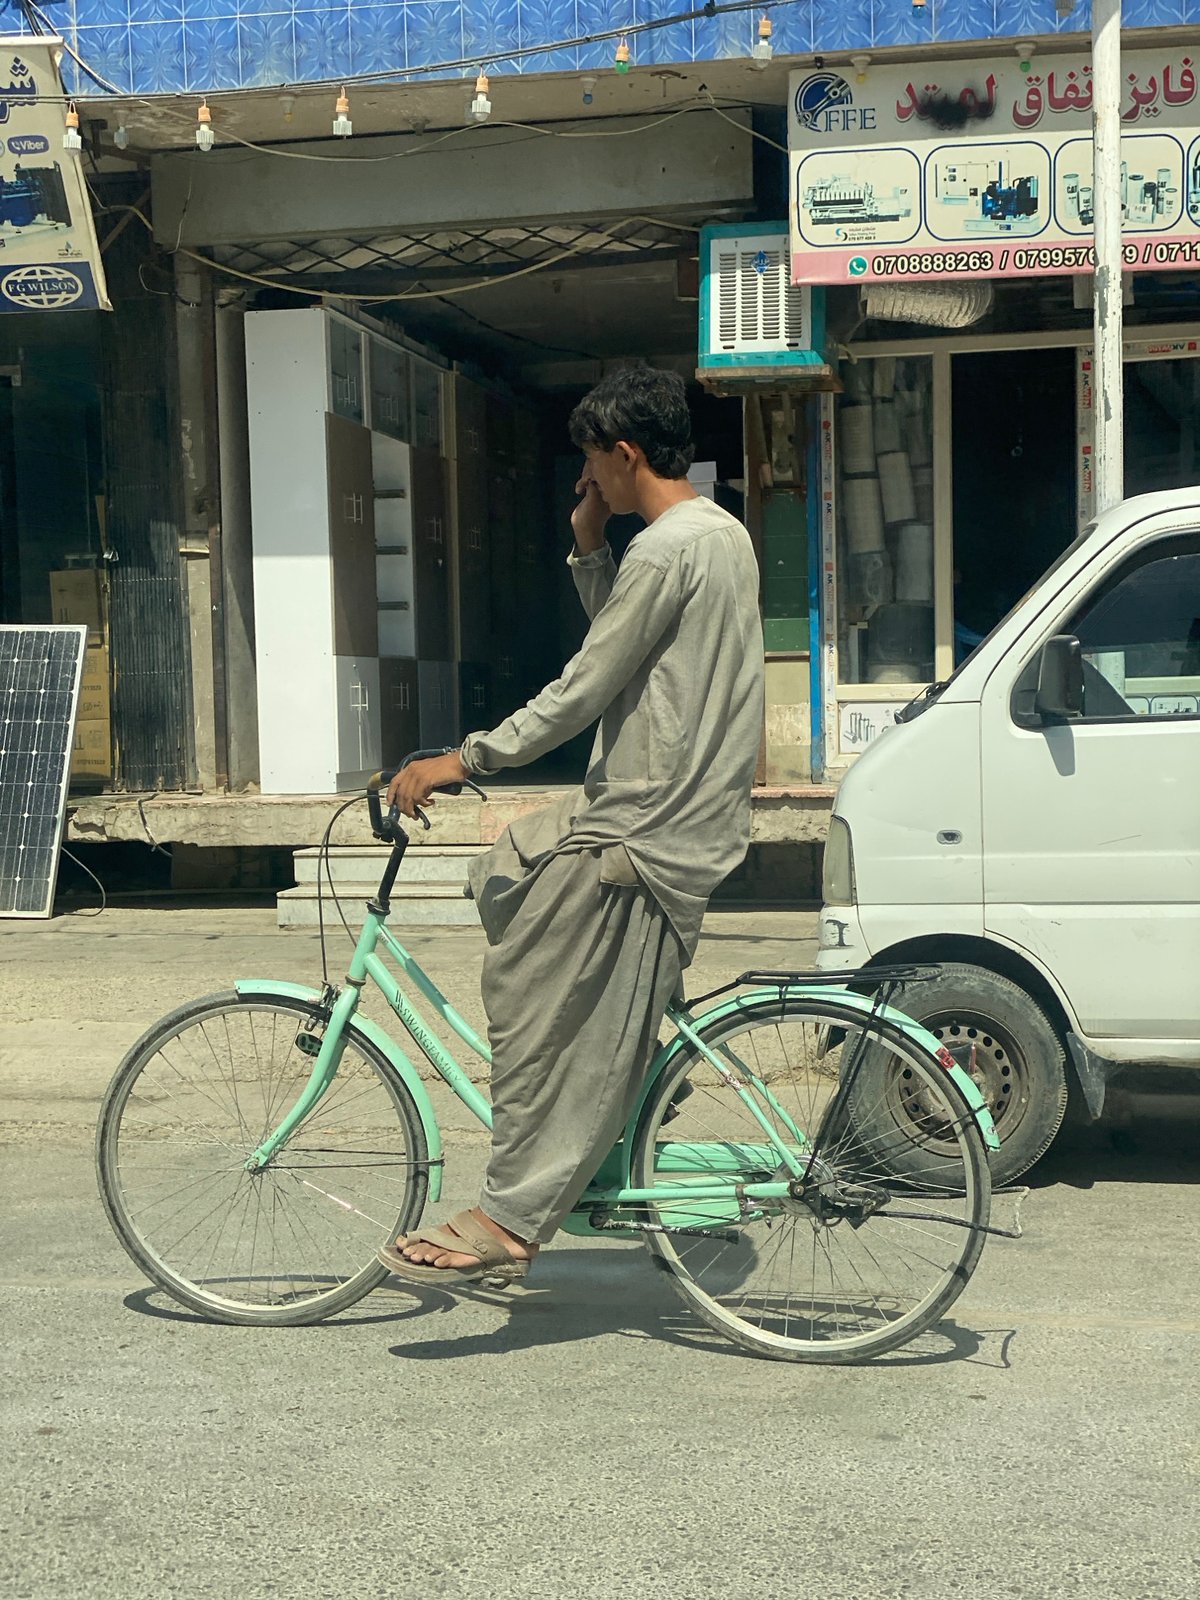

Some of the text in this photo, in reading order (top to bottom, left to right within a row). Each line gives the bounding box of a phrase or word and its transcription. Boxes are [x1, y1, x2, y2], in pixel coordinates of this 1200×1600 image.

[824, 108, 877, 132] FFE
[20, 139, 45, 151] Viber
[872, 251, 993, 275] 0708888263
[27, 281, 76, 292] WILSON
